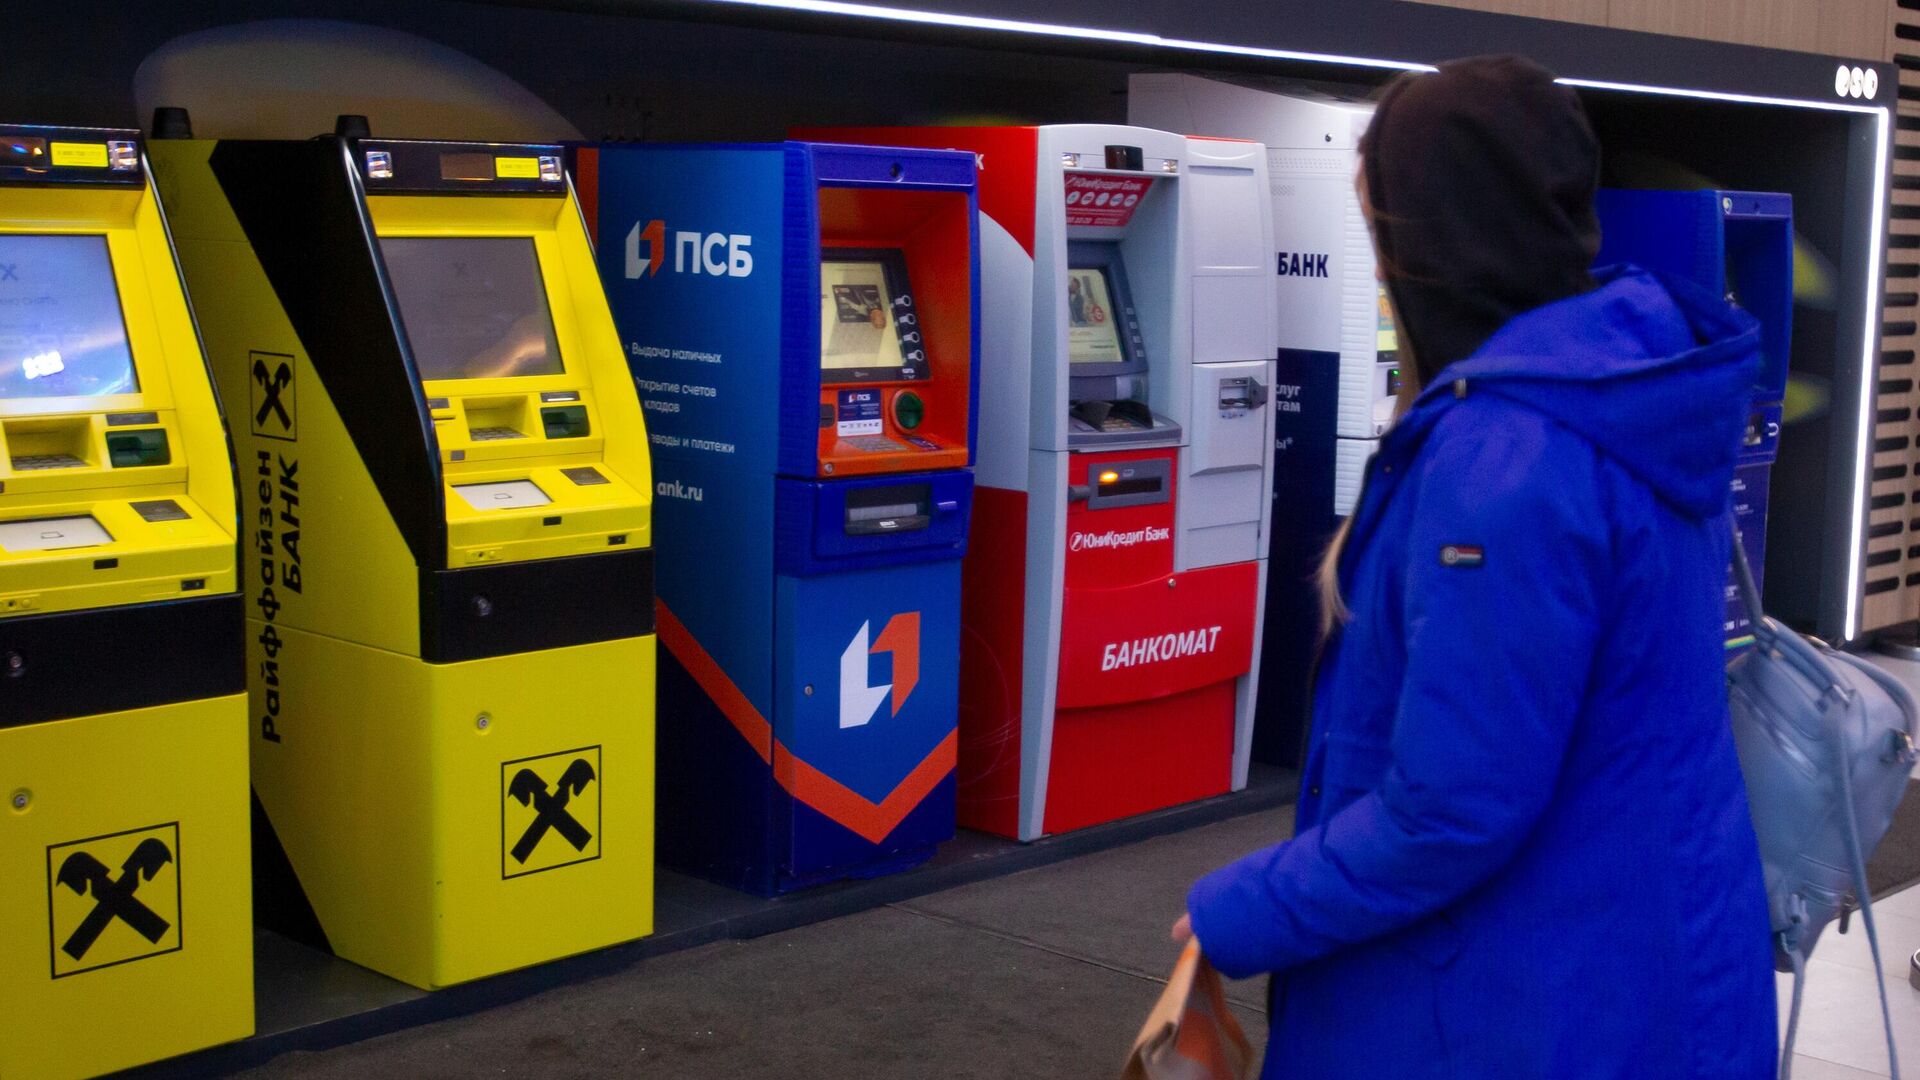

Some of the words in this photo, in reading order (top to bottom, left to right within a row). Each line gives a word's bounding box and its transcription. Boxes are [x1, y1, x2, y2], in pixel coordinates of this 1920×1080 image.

[675, 230, 754, 278] ПСБ
[1277, 252, 1329, 278] БАНК
[632, 342, 670, 358] Выдача
[671, 349, 722, 364] наличных
[681, 384, 717, 397] счетов
[644, 400, 680, 414] кладов
[682, 438, 690, 448] и
[691, 439, 735, 454] платежи
[656, 480, 703, 501] ank.ru
[279, 453, 303, 595] БАНК
[1083, 530, 1145, 549] ЮниКредит
[1145, 526, 1170, 542] Банк
[256, 450, 283, 744] Райффайзен
[1102, 626, 1222, 671] БАНКОМАТ
